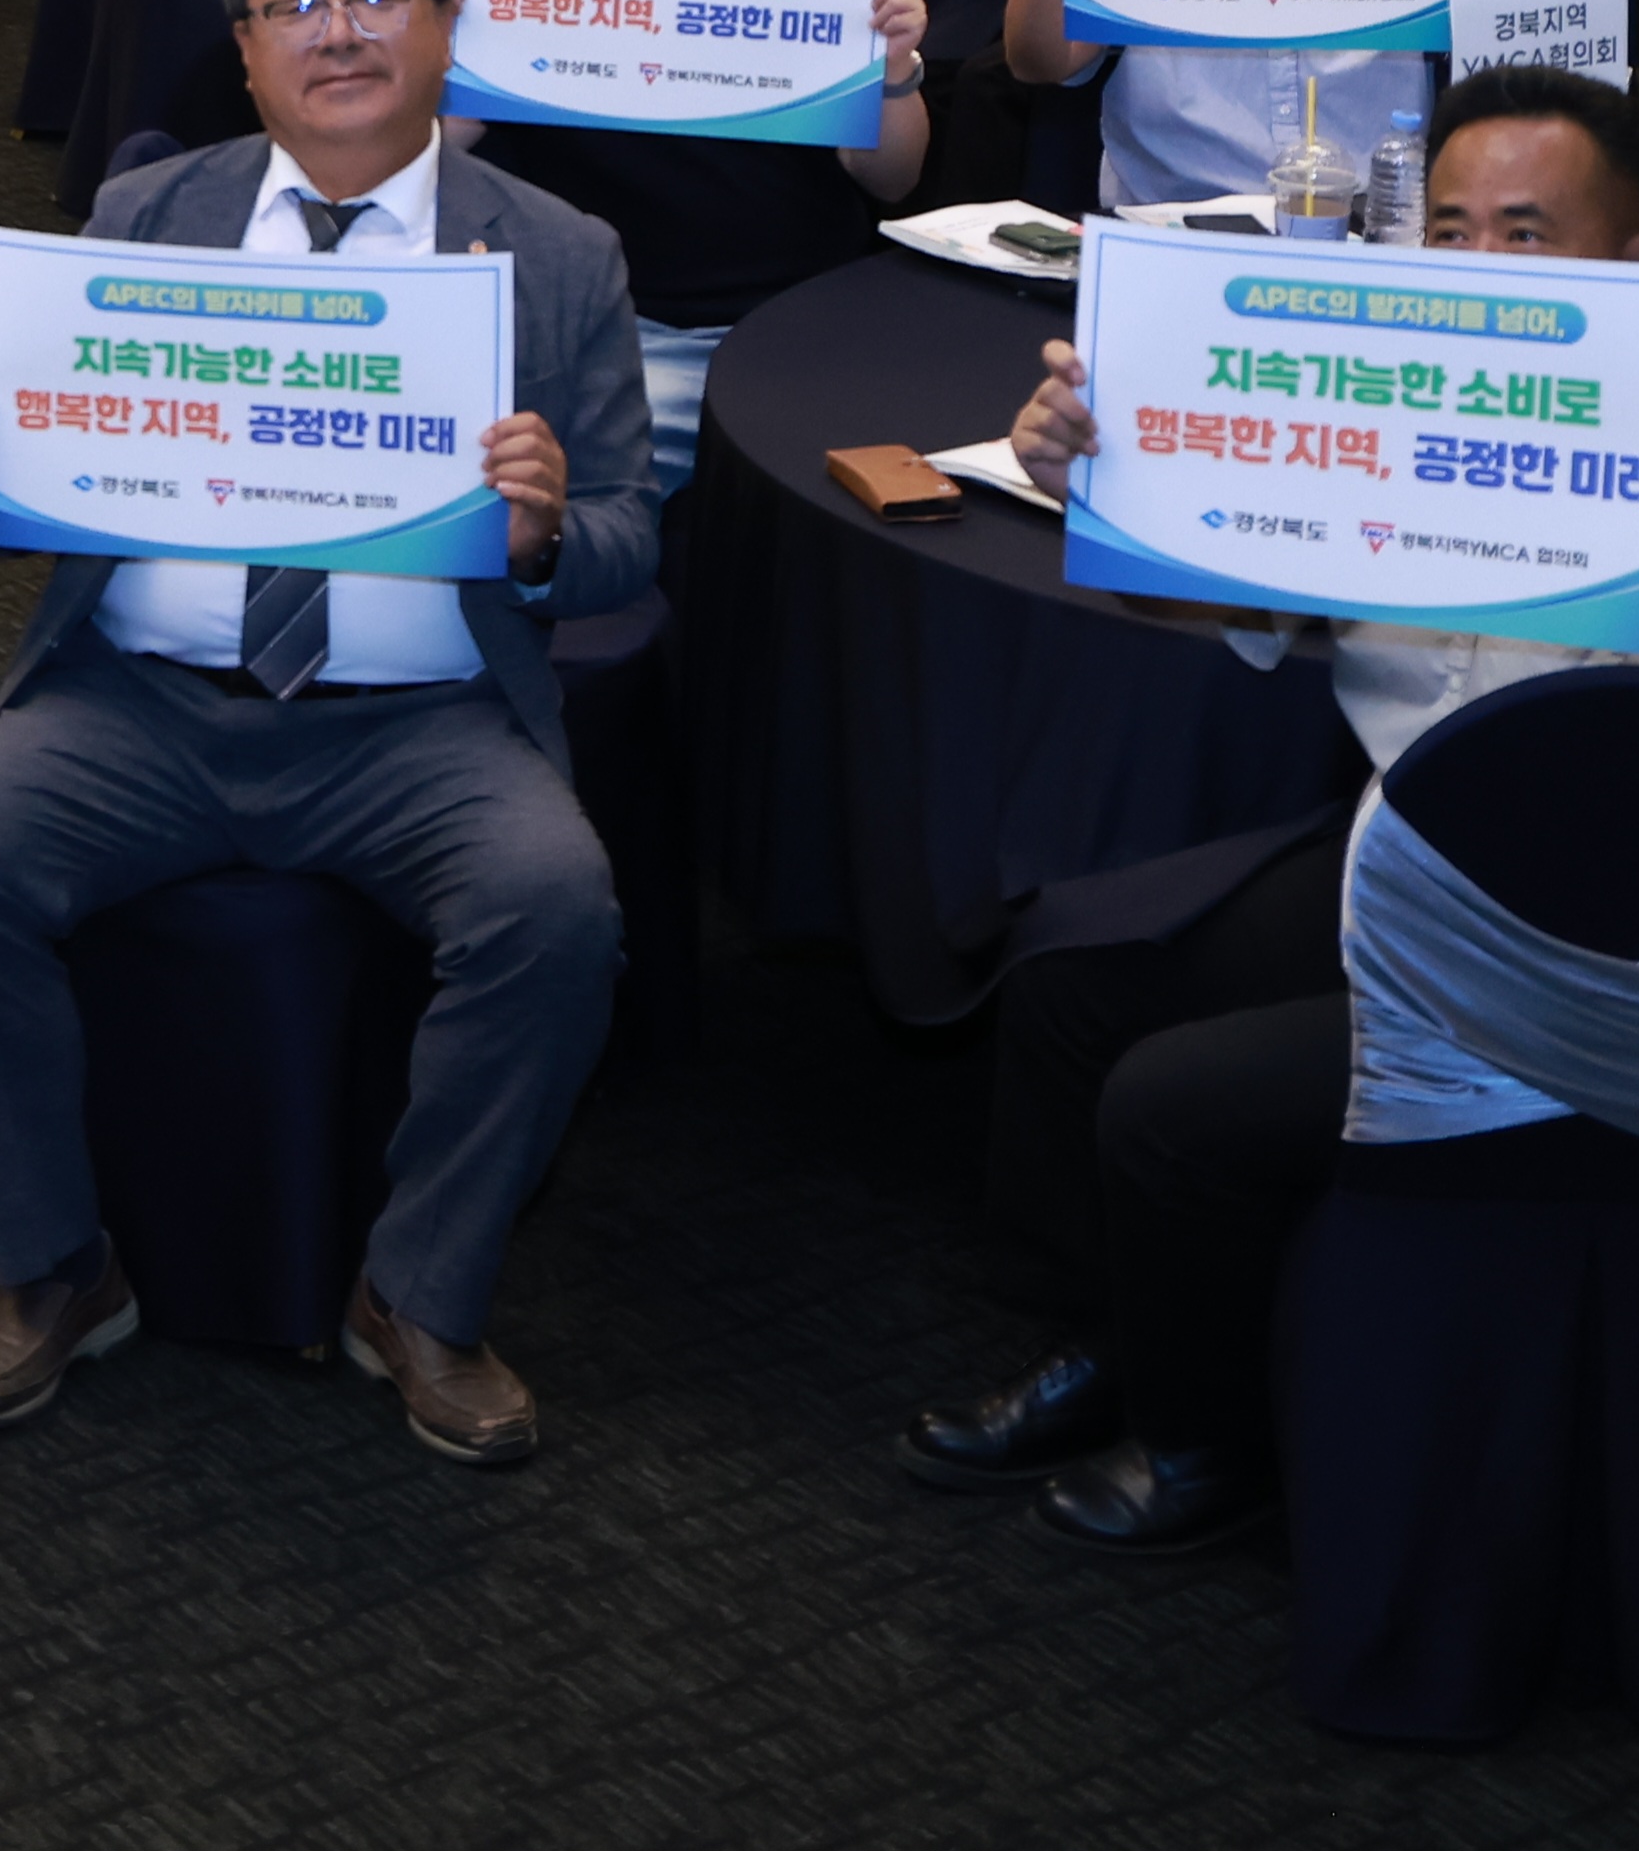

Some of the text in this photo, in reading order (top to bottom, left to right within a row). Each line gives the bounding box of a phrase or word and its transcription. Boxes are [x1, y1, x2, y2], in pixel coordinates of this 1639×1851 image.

[1496, 2, 1587, 42] 경북지역
[1247, 284, 1562, 335] APEC의 발자취를 넘어,
[73, 337, 400, 394] 지속가능한 소비로
[1208, 346, 1600, 427] 지속가능한 소비로
[13, 388, 455, 455] 행복한 지역, 공정한 미래
[1135, 405, 1276, 465] 행복한
[1283, 424, 1390, 480] 지역,
[1413, 434, 1559, 494] 공정한
